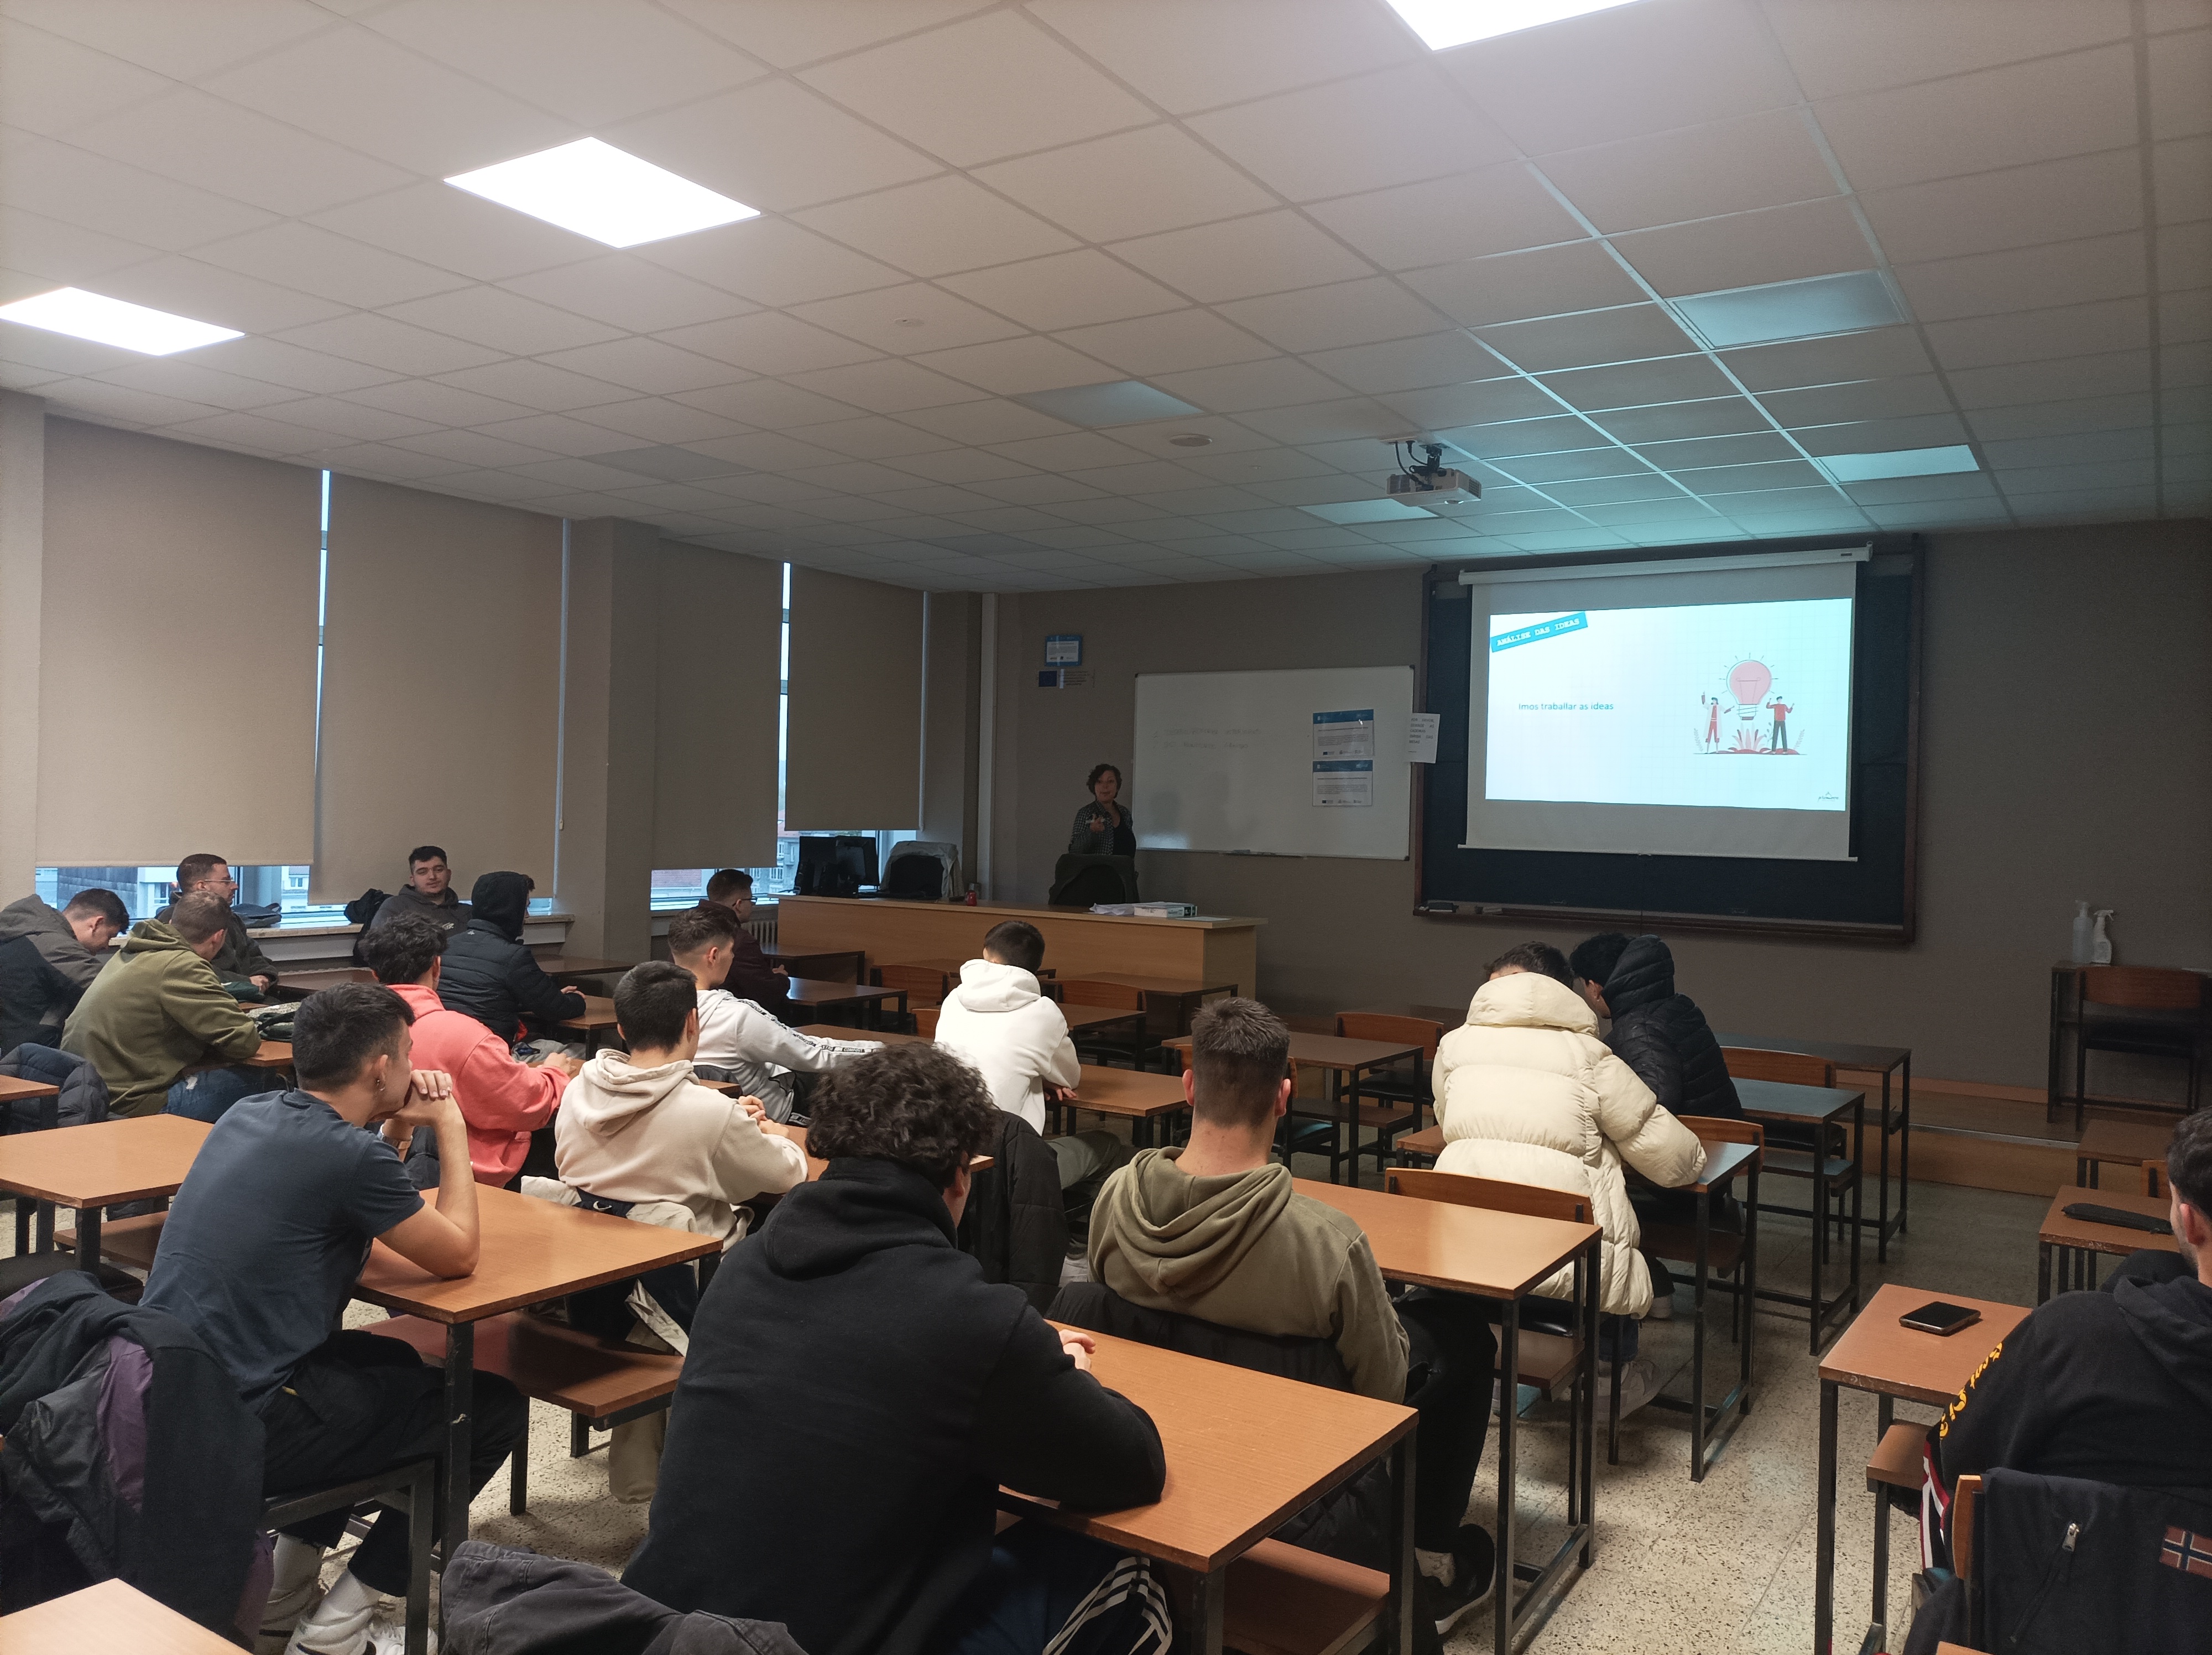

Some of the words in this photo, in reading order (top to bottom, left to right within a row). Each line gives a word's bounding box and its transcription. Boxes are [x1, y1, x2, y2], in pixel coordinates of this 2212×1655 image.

[1496, 631, 1531, 647] ANÁLISE
[1534, 626, 1551, 636] DAS
[1554, 618, 1580, 631] IDEAS
